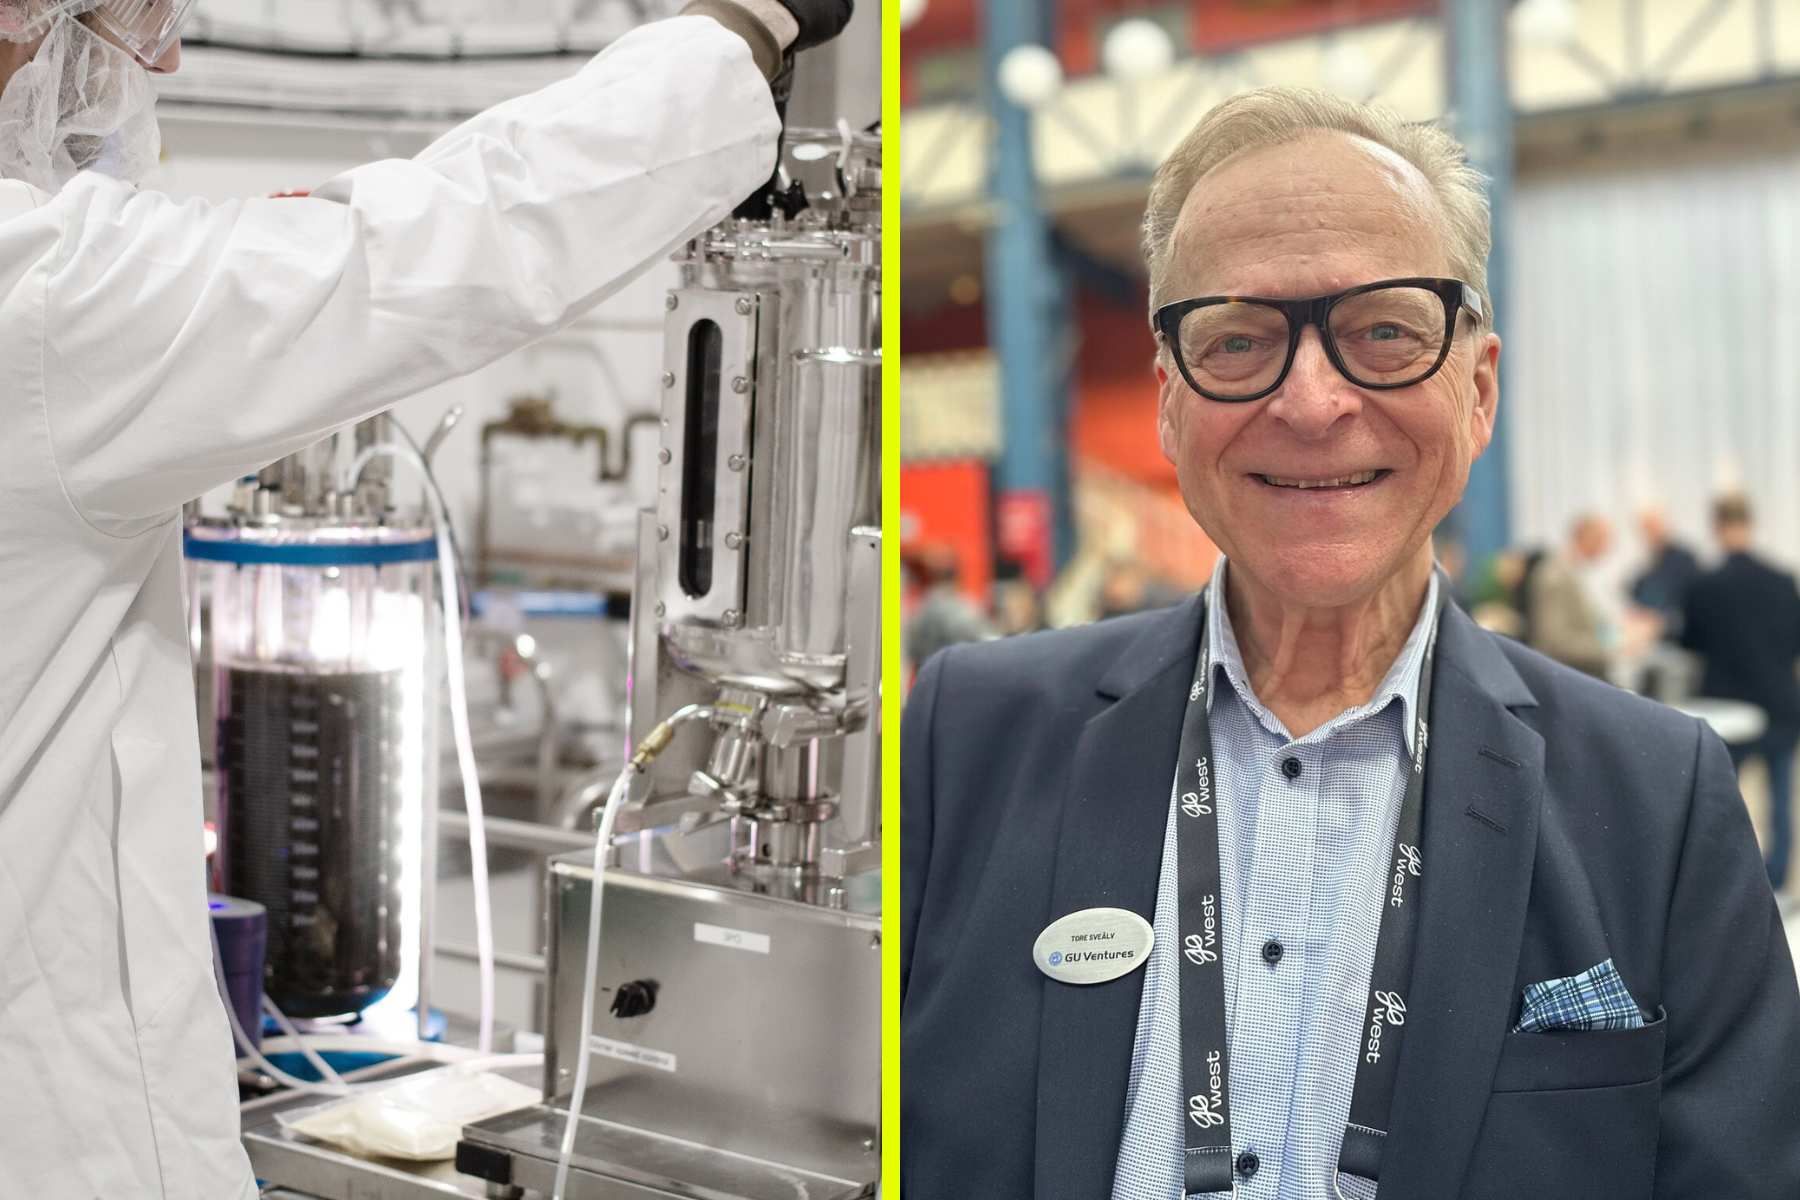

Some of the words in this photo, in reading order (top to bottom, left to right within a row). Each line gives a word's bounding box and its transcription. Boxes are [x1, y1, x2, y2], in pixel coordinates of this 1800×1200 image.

[1195, 756, 1210, 802] west
[1391, 858, 1408, 908] west
[1201, 894, 1216, 946] west
[1065, 953, 1081, 962] GU
[1083, 950, 1134, 961] Ventures
[1366, 1007, 1384, 1064] west
[1206, 1050, 1222, 1108] west
